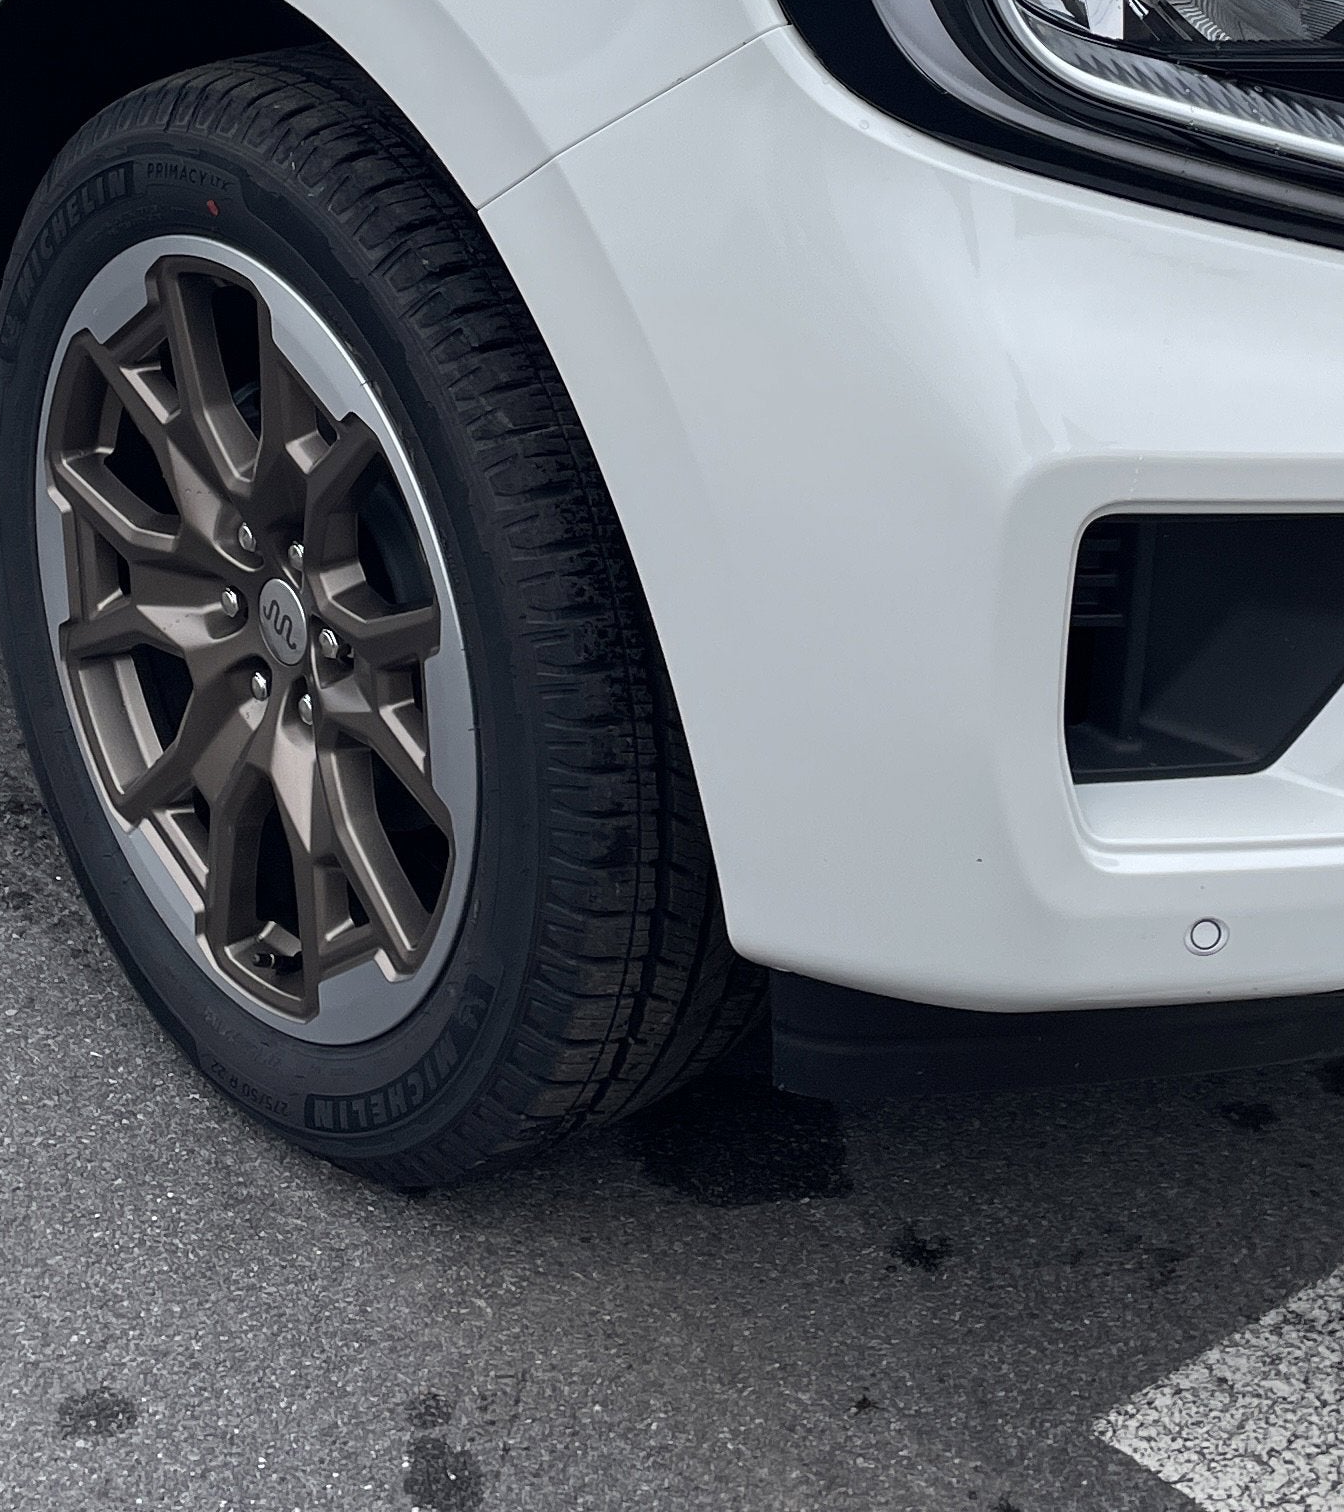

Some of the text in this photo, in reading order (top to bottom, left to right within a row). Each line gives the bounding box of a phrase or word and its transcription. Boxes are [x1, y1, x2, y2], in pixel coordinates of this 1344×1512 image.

[147, 162, 208, 186] PRIMACY
[17, 167, 127, 306] MICHELIN
[313, 1028, 458, 1130] MICHELIN
